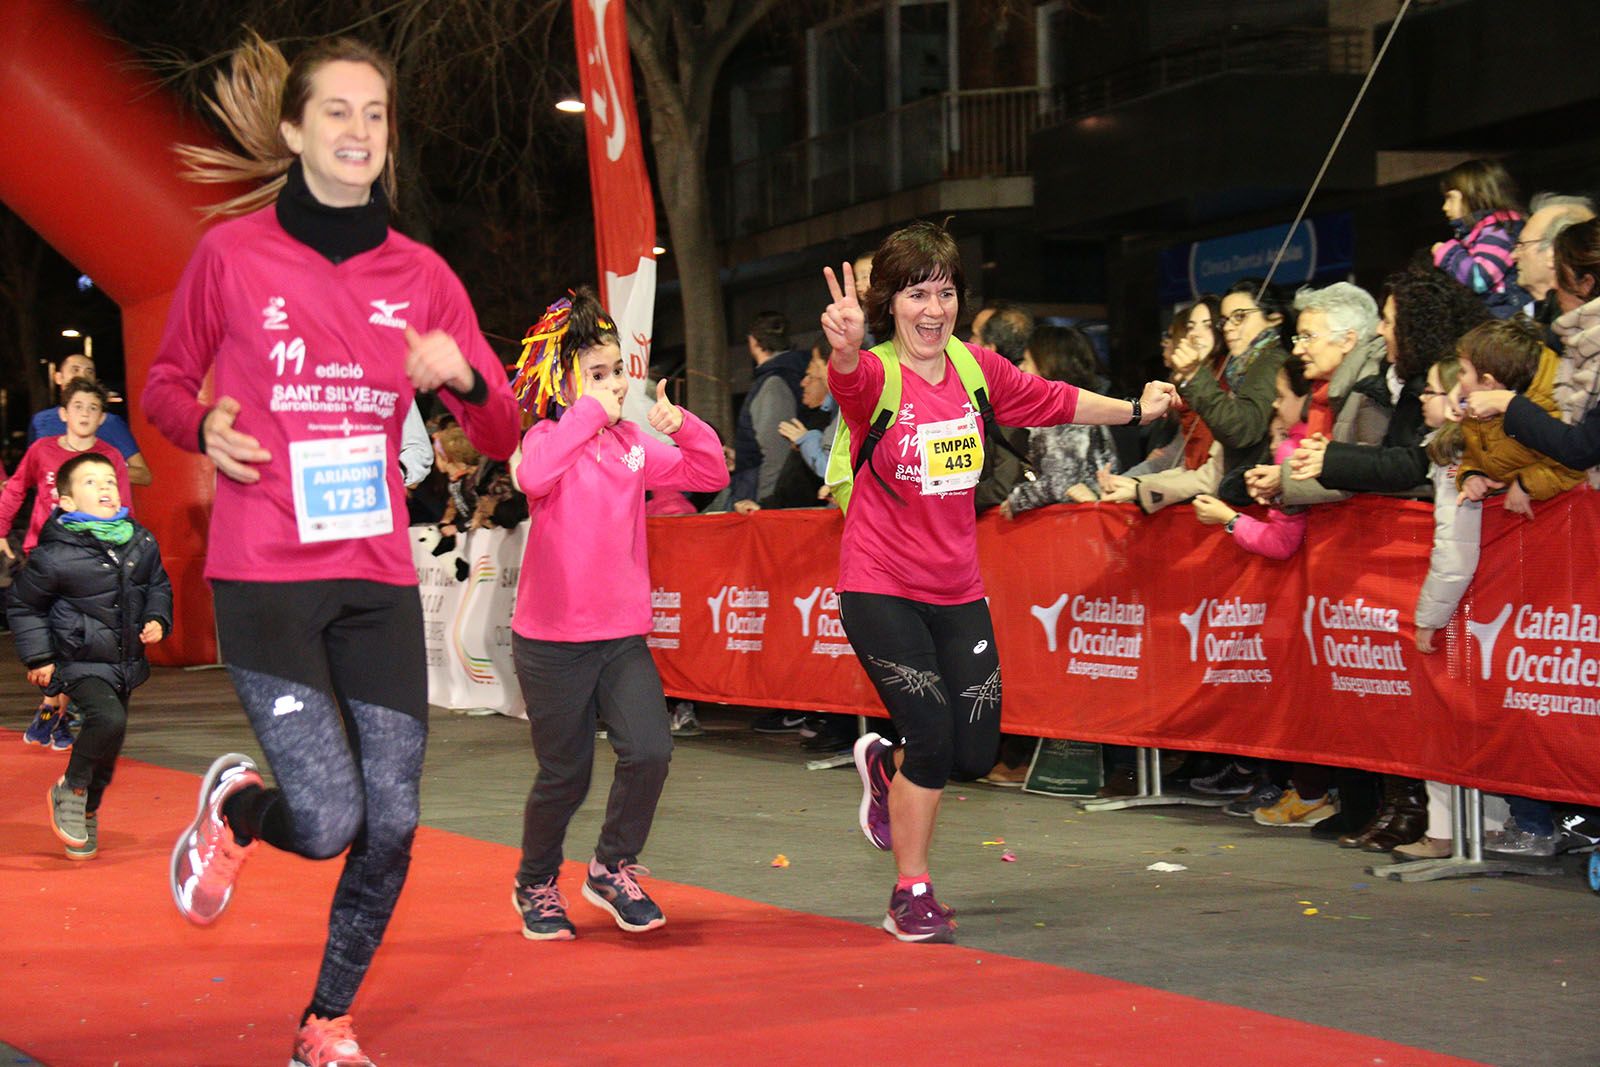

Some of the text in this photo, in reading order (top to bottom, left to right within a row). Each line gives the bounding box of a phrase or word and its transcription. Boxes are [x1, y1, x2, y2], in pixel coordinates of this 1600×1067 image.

[269, 337, 364, 379] 19 edició
[272, 384, 322, 401] SANT
[934, 437, 977, 454] EMPAR
[313, 465, 379, 485] ARIADNA
[945, 454, 972, 471] 443
[323, 485, 377, 512] 1738
[1071, 595, 1145, 625] Catalana
[1319, 597, 1399, 633] Catalana
[1068, 627, 1143, 658] Occident
[1323, 634, 1407, 671] Occident
[1331, 671, 1412, 697] Assegurances
